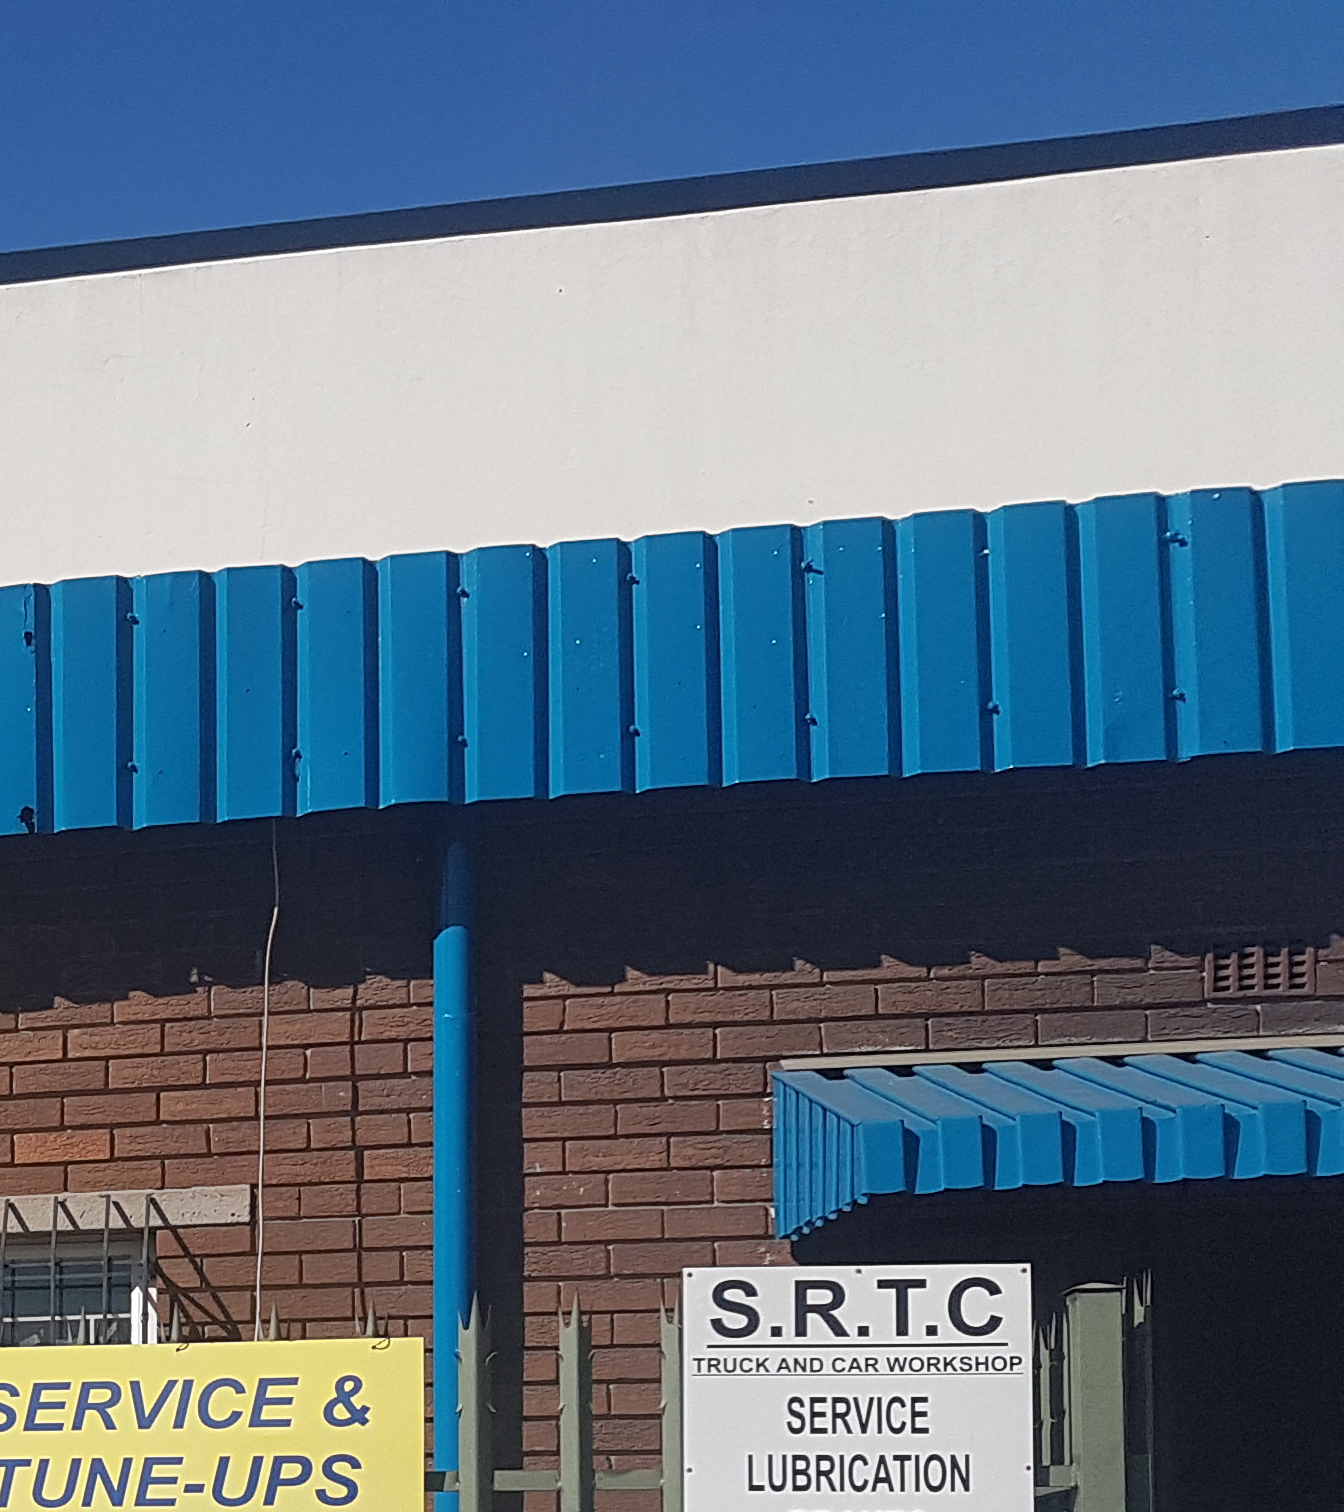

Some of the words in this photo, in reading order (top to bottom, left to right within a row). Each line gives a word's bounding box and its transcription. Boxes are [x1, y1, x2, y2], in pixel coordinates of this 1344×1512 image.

[709, 1277, 1003, 1338] S.R.T.C
[693, 1357, 770, 1374] TRUCK
[777, 1357, 824, 1373] AND
[831, 1356, 879, 1373] CAR
[886, 1355, 1023, 1373] WORKSHOP
[323, 1374, 371, 1426] &
[786, 1396, 930, 1435] SERVICE
[747, 1454, 971, 1493] LUBRICATION
